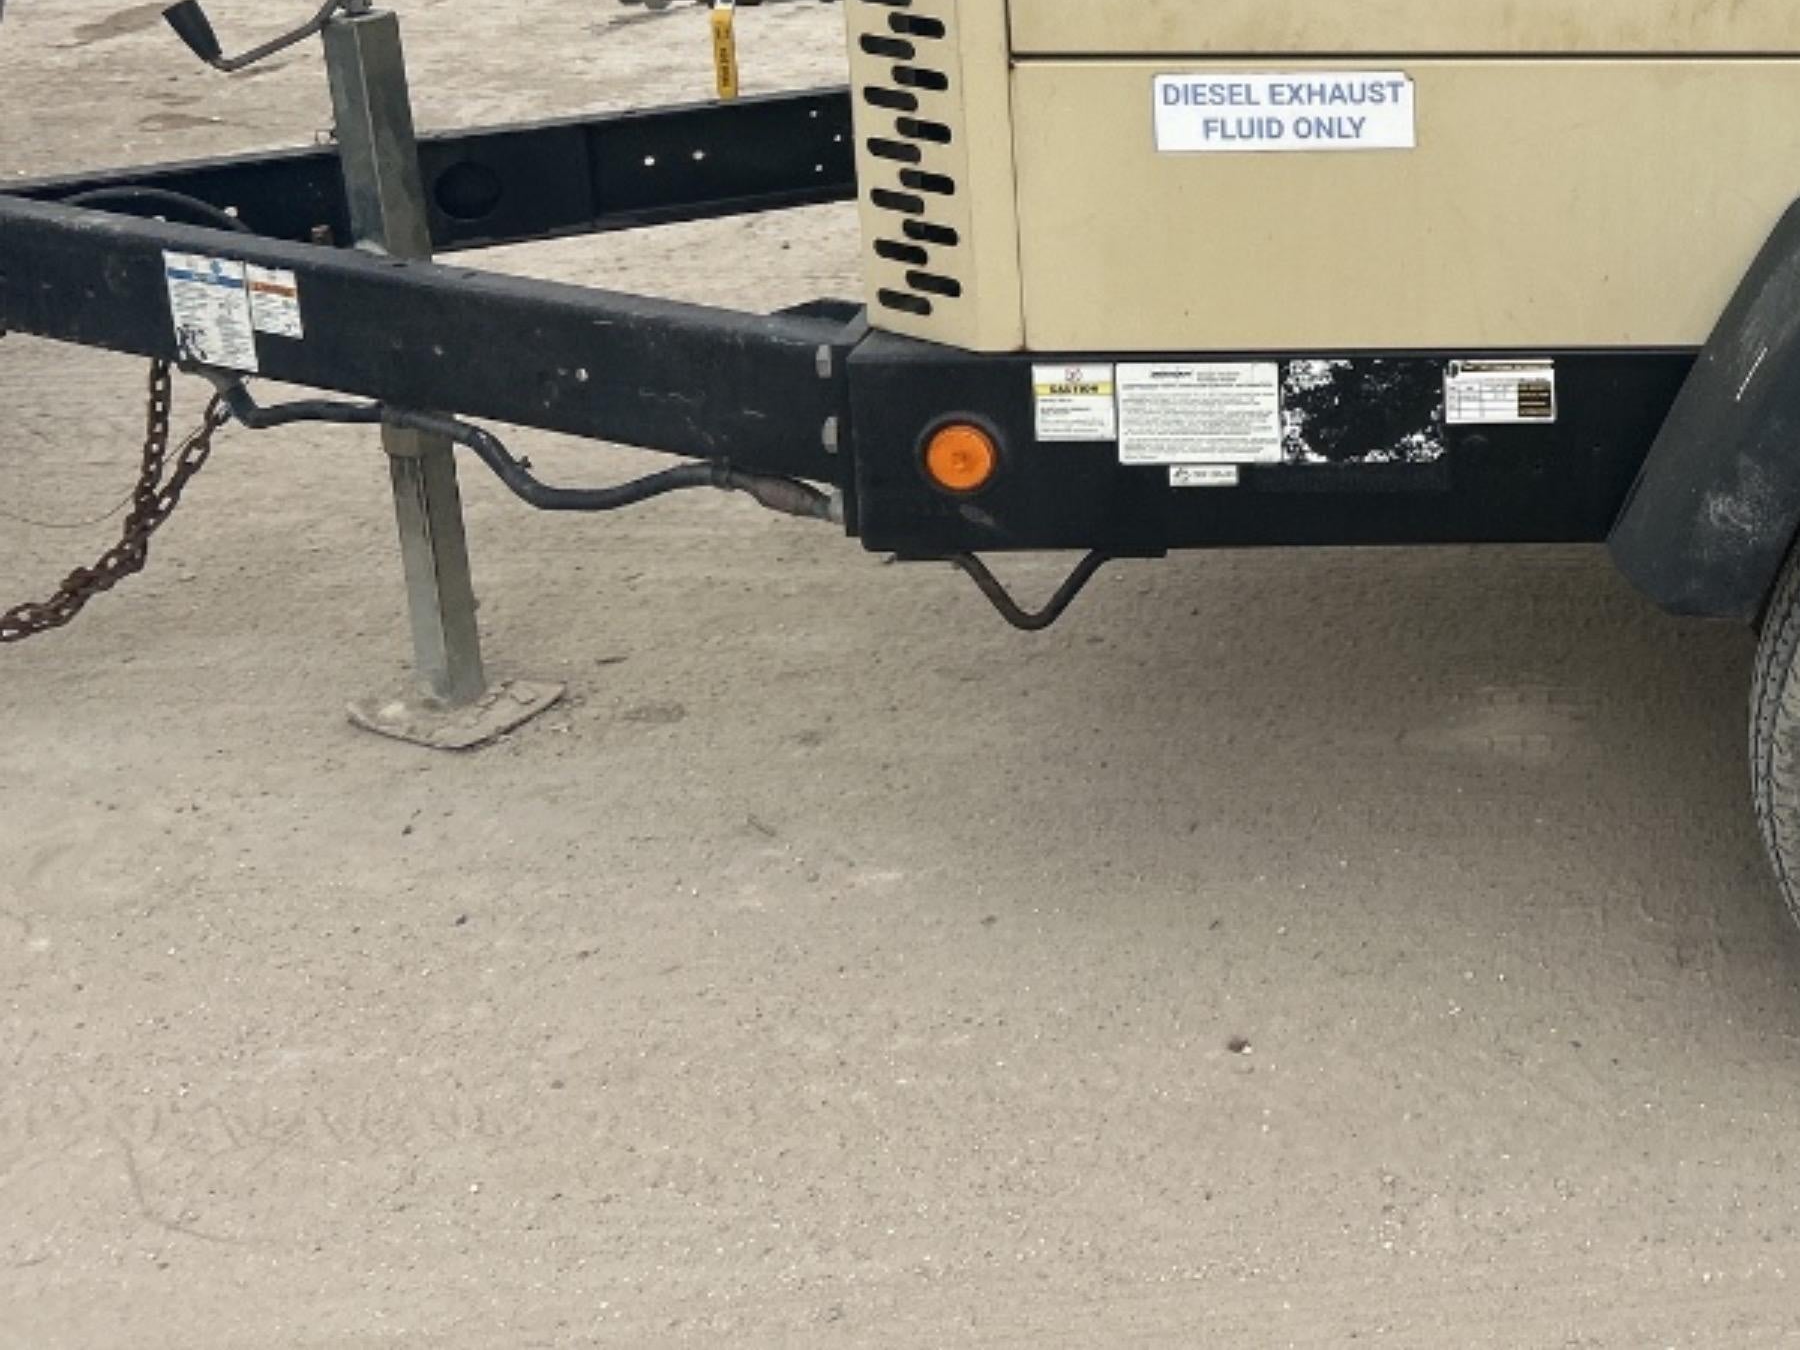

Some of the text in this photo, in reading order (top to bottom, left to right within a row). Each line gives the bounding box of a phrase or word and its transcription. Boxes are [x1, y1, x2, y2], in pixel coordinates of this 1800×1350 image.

[1162, 81, 1404, 106] DIESEL EXHAUST
[1202, 116, 1366, 140] FLUID ONLY
